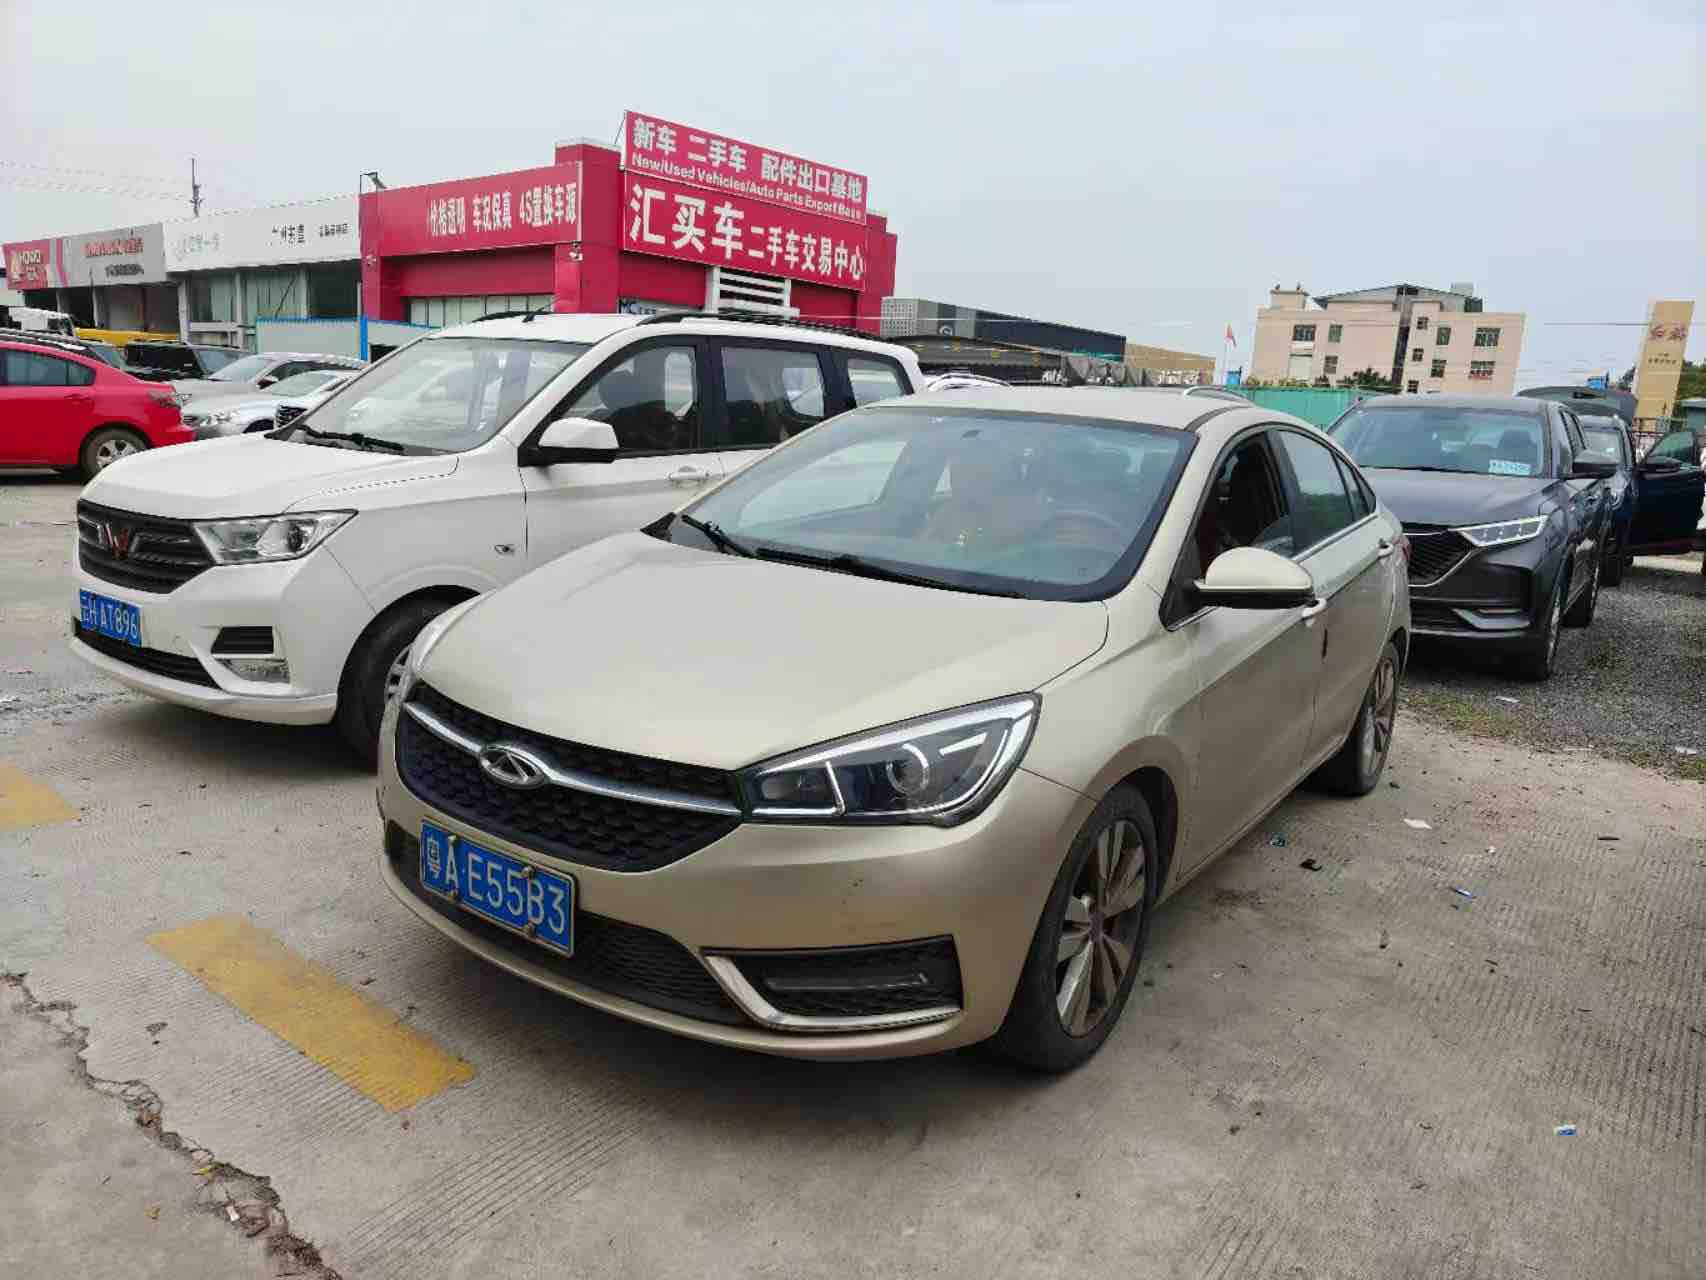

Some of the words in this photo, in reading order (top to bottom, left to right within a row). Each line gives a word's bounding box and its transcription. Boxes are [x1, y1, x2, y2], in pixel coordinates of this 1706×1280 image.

[633, 118, 676, 156] 新车
[687, 134, 747, 172] 二手车
[761, 153, 863, 203] 配件出口基地
[629, 183, 745, 260] 汇买车
[748, 226, 864, 280] 二手车交易中心
